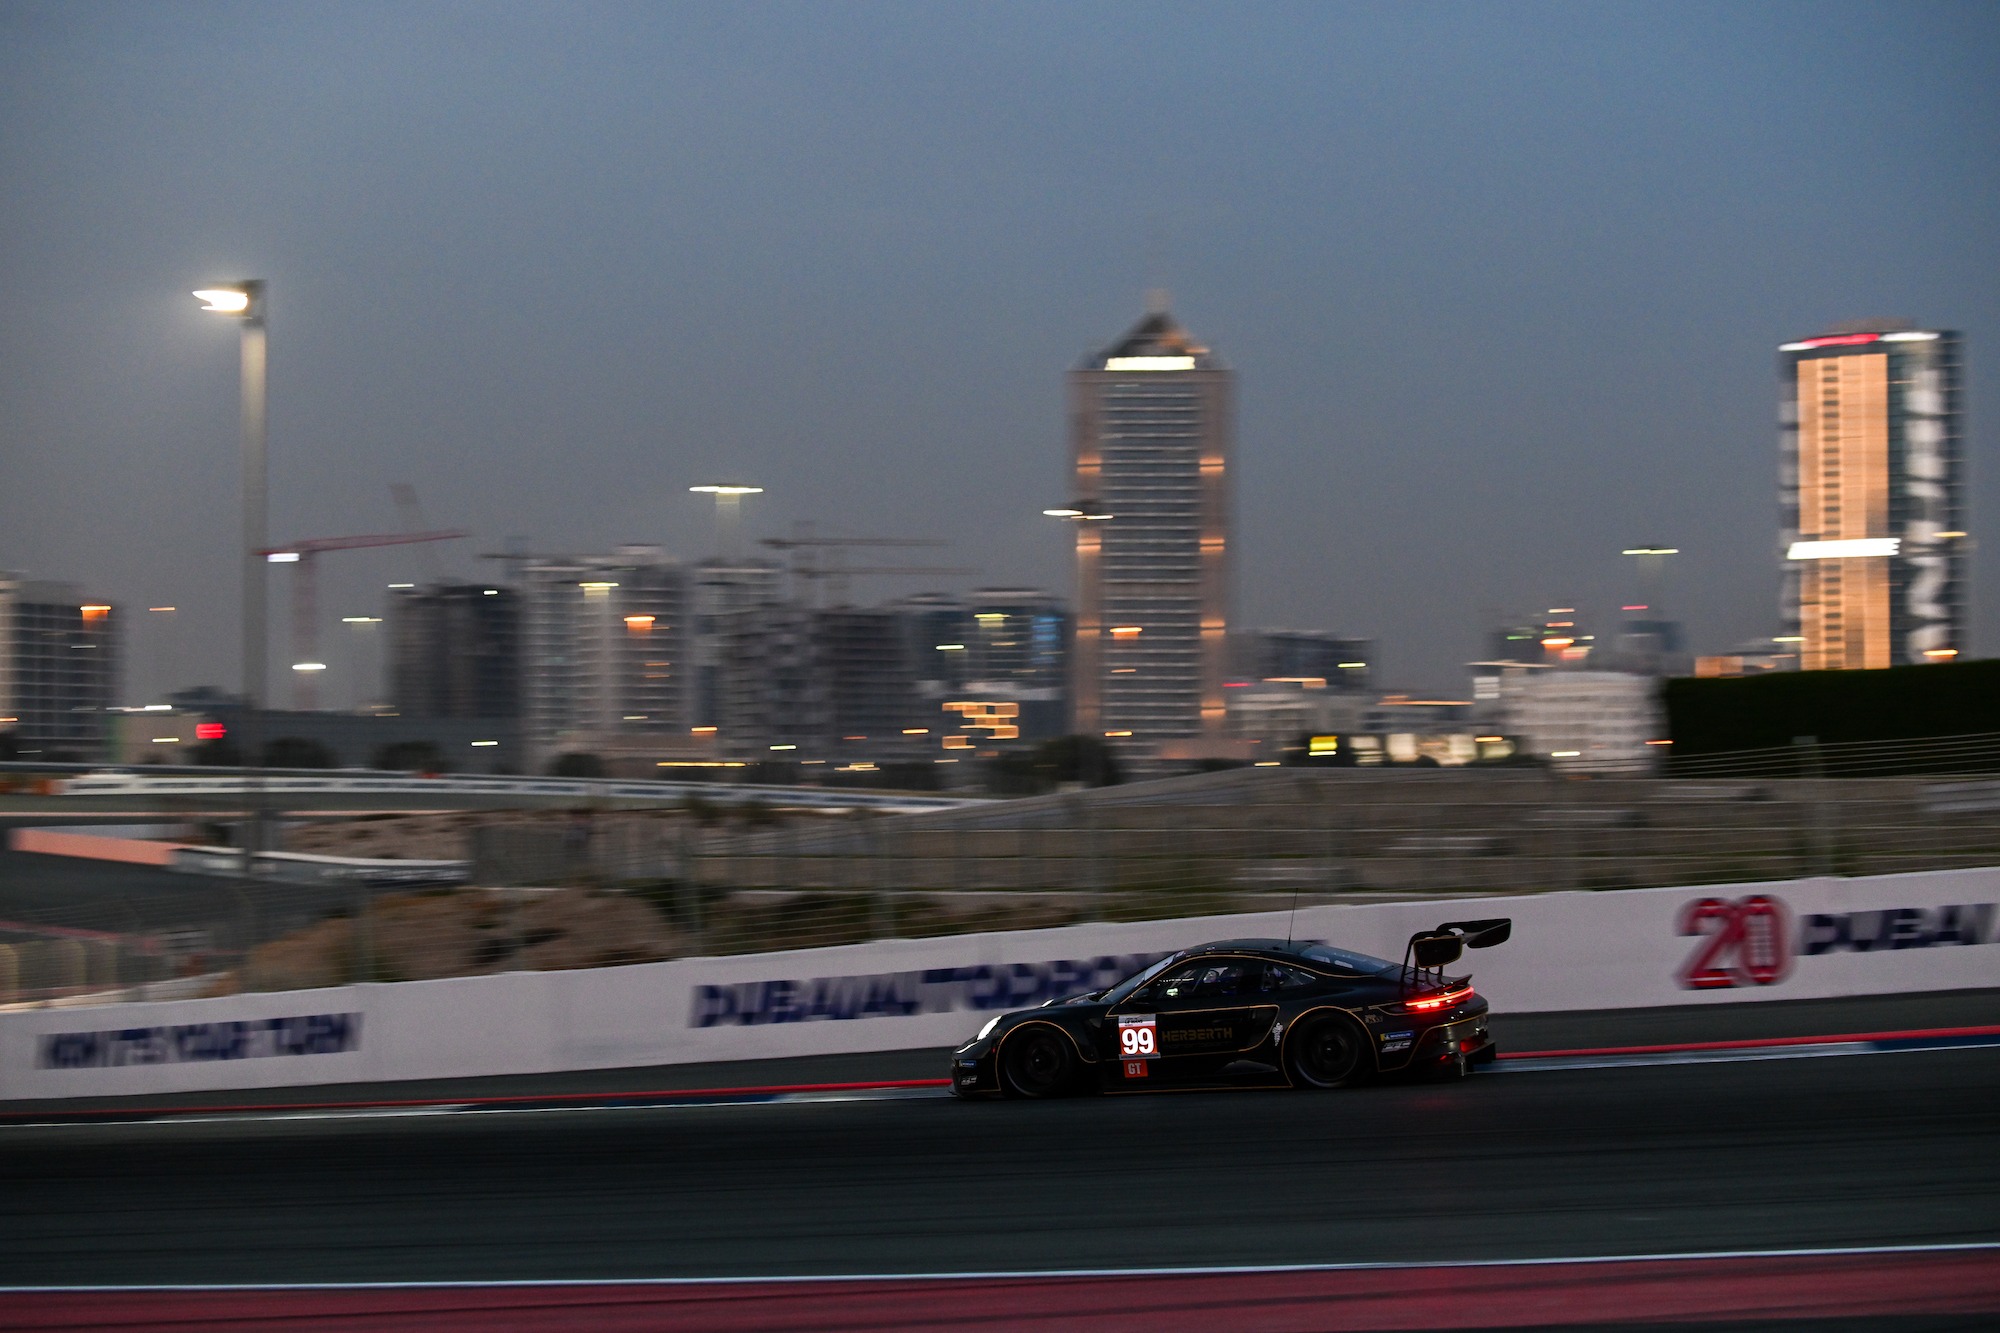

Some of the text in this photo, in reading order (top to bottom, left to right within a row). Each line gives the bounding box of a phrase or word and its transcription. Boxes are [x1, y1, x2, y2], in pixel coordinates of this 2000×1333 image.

[1677, 894, 1998, 990] 20 DUBAI
[1121, 1028, 1155, 1055] 99
[1161, 1027, 1233, 1042] HERBERTH
[1127, 1062, 1142, 1075] GT
